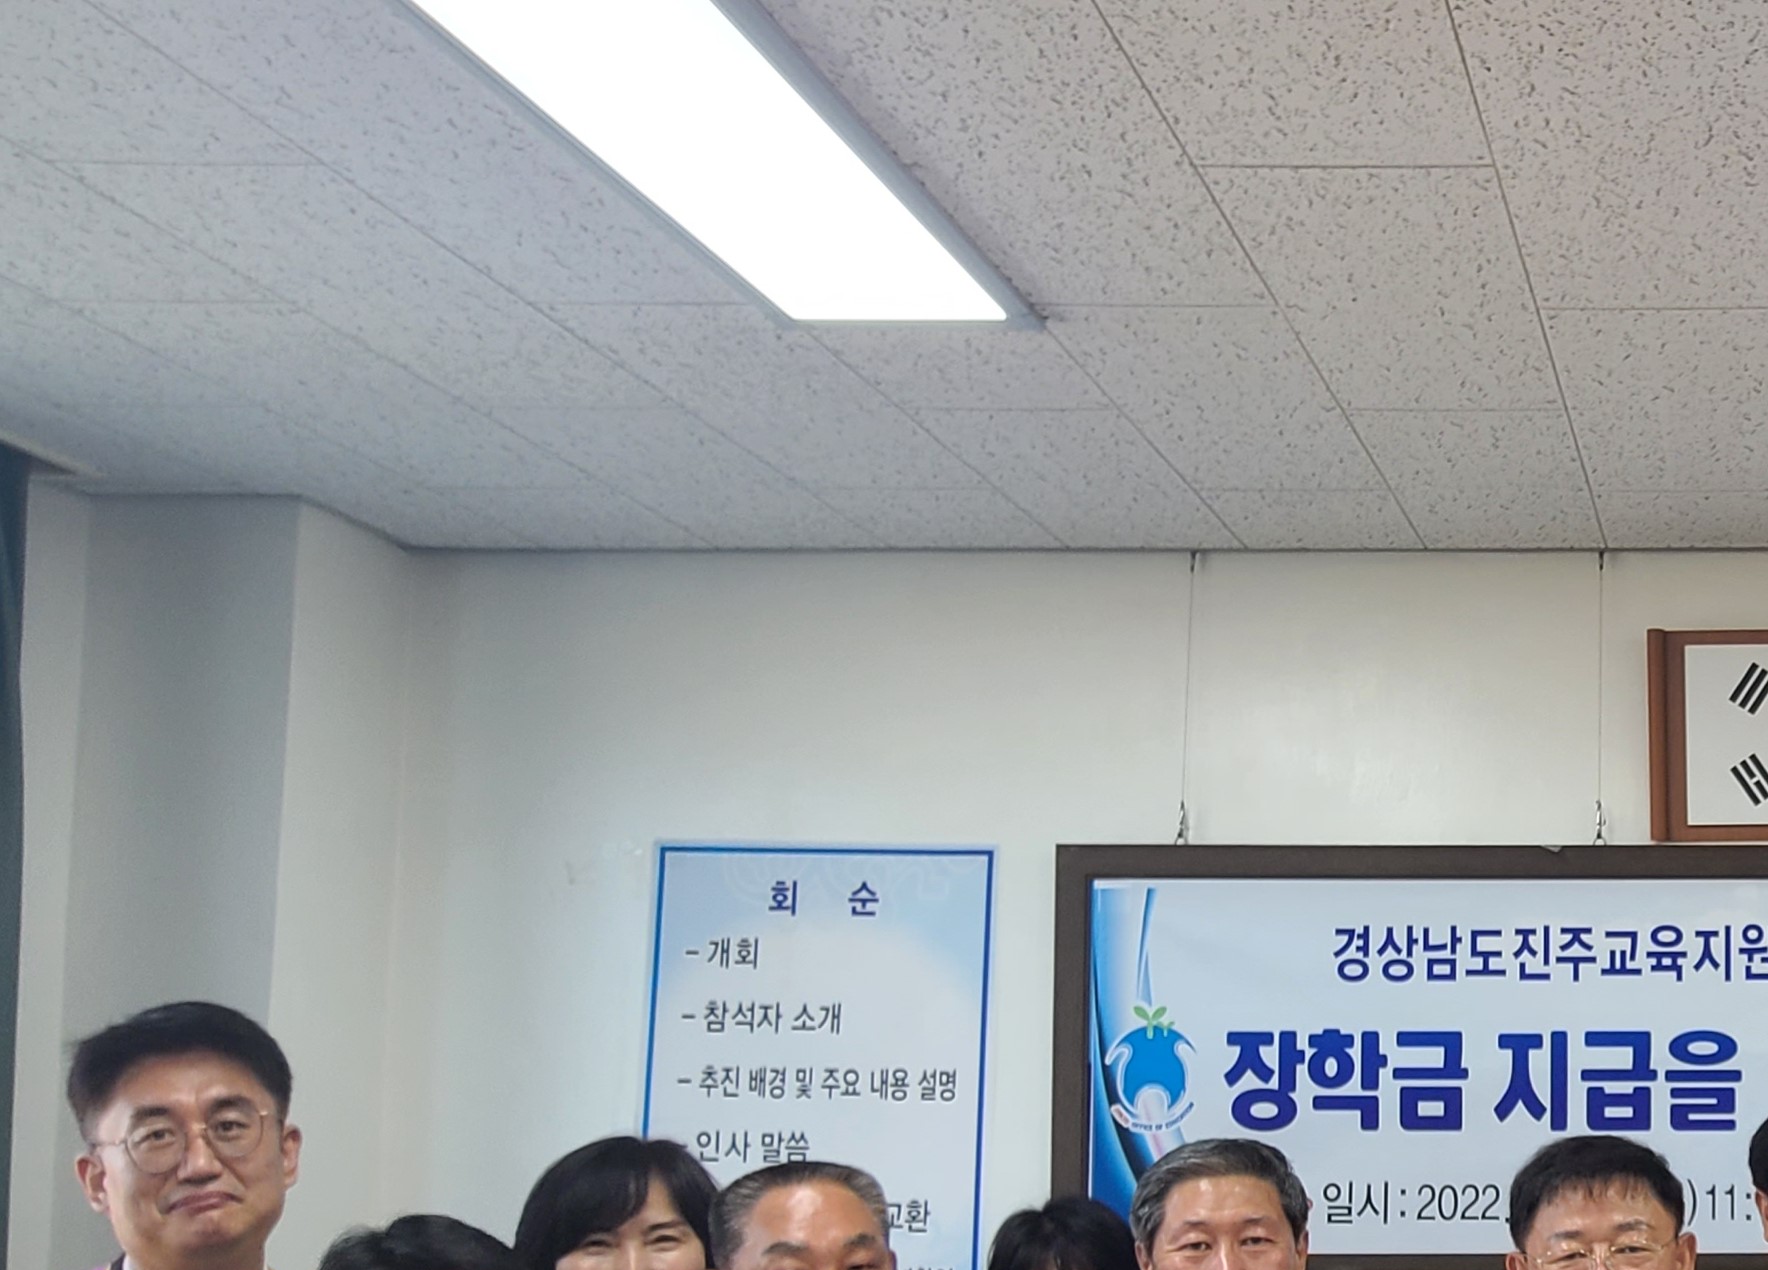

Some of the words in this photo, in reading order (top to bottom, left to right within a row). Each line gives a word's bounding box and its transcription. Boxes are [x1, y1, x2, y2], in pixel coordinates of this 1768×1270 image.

[768, 879, 798, 917] 회
[848, 880, 880, 917] 순
[707, 936, 759, 969] 개회
[703, 999, 783, 1035] 참석자
[791, 1002, 842, 1035] 소개
[699, 1065, 740, 1098] 추진
[749, 1066, 787, 1099] 배경
[795, 1067, 814, 1099] 및
[821, 1068, 862, 1100] 주요
[870, 1068, 910, 1101] 내용
[918, 1068, 957, 1101] 설명
[1224, 1029, 1469, 1132] 장학금
[1494, 1032, 1743, 1132] 지급을
[696, 1130, 751, 1163] 인사
[761, 1131, 811, 1164] 말씀
